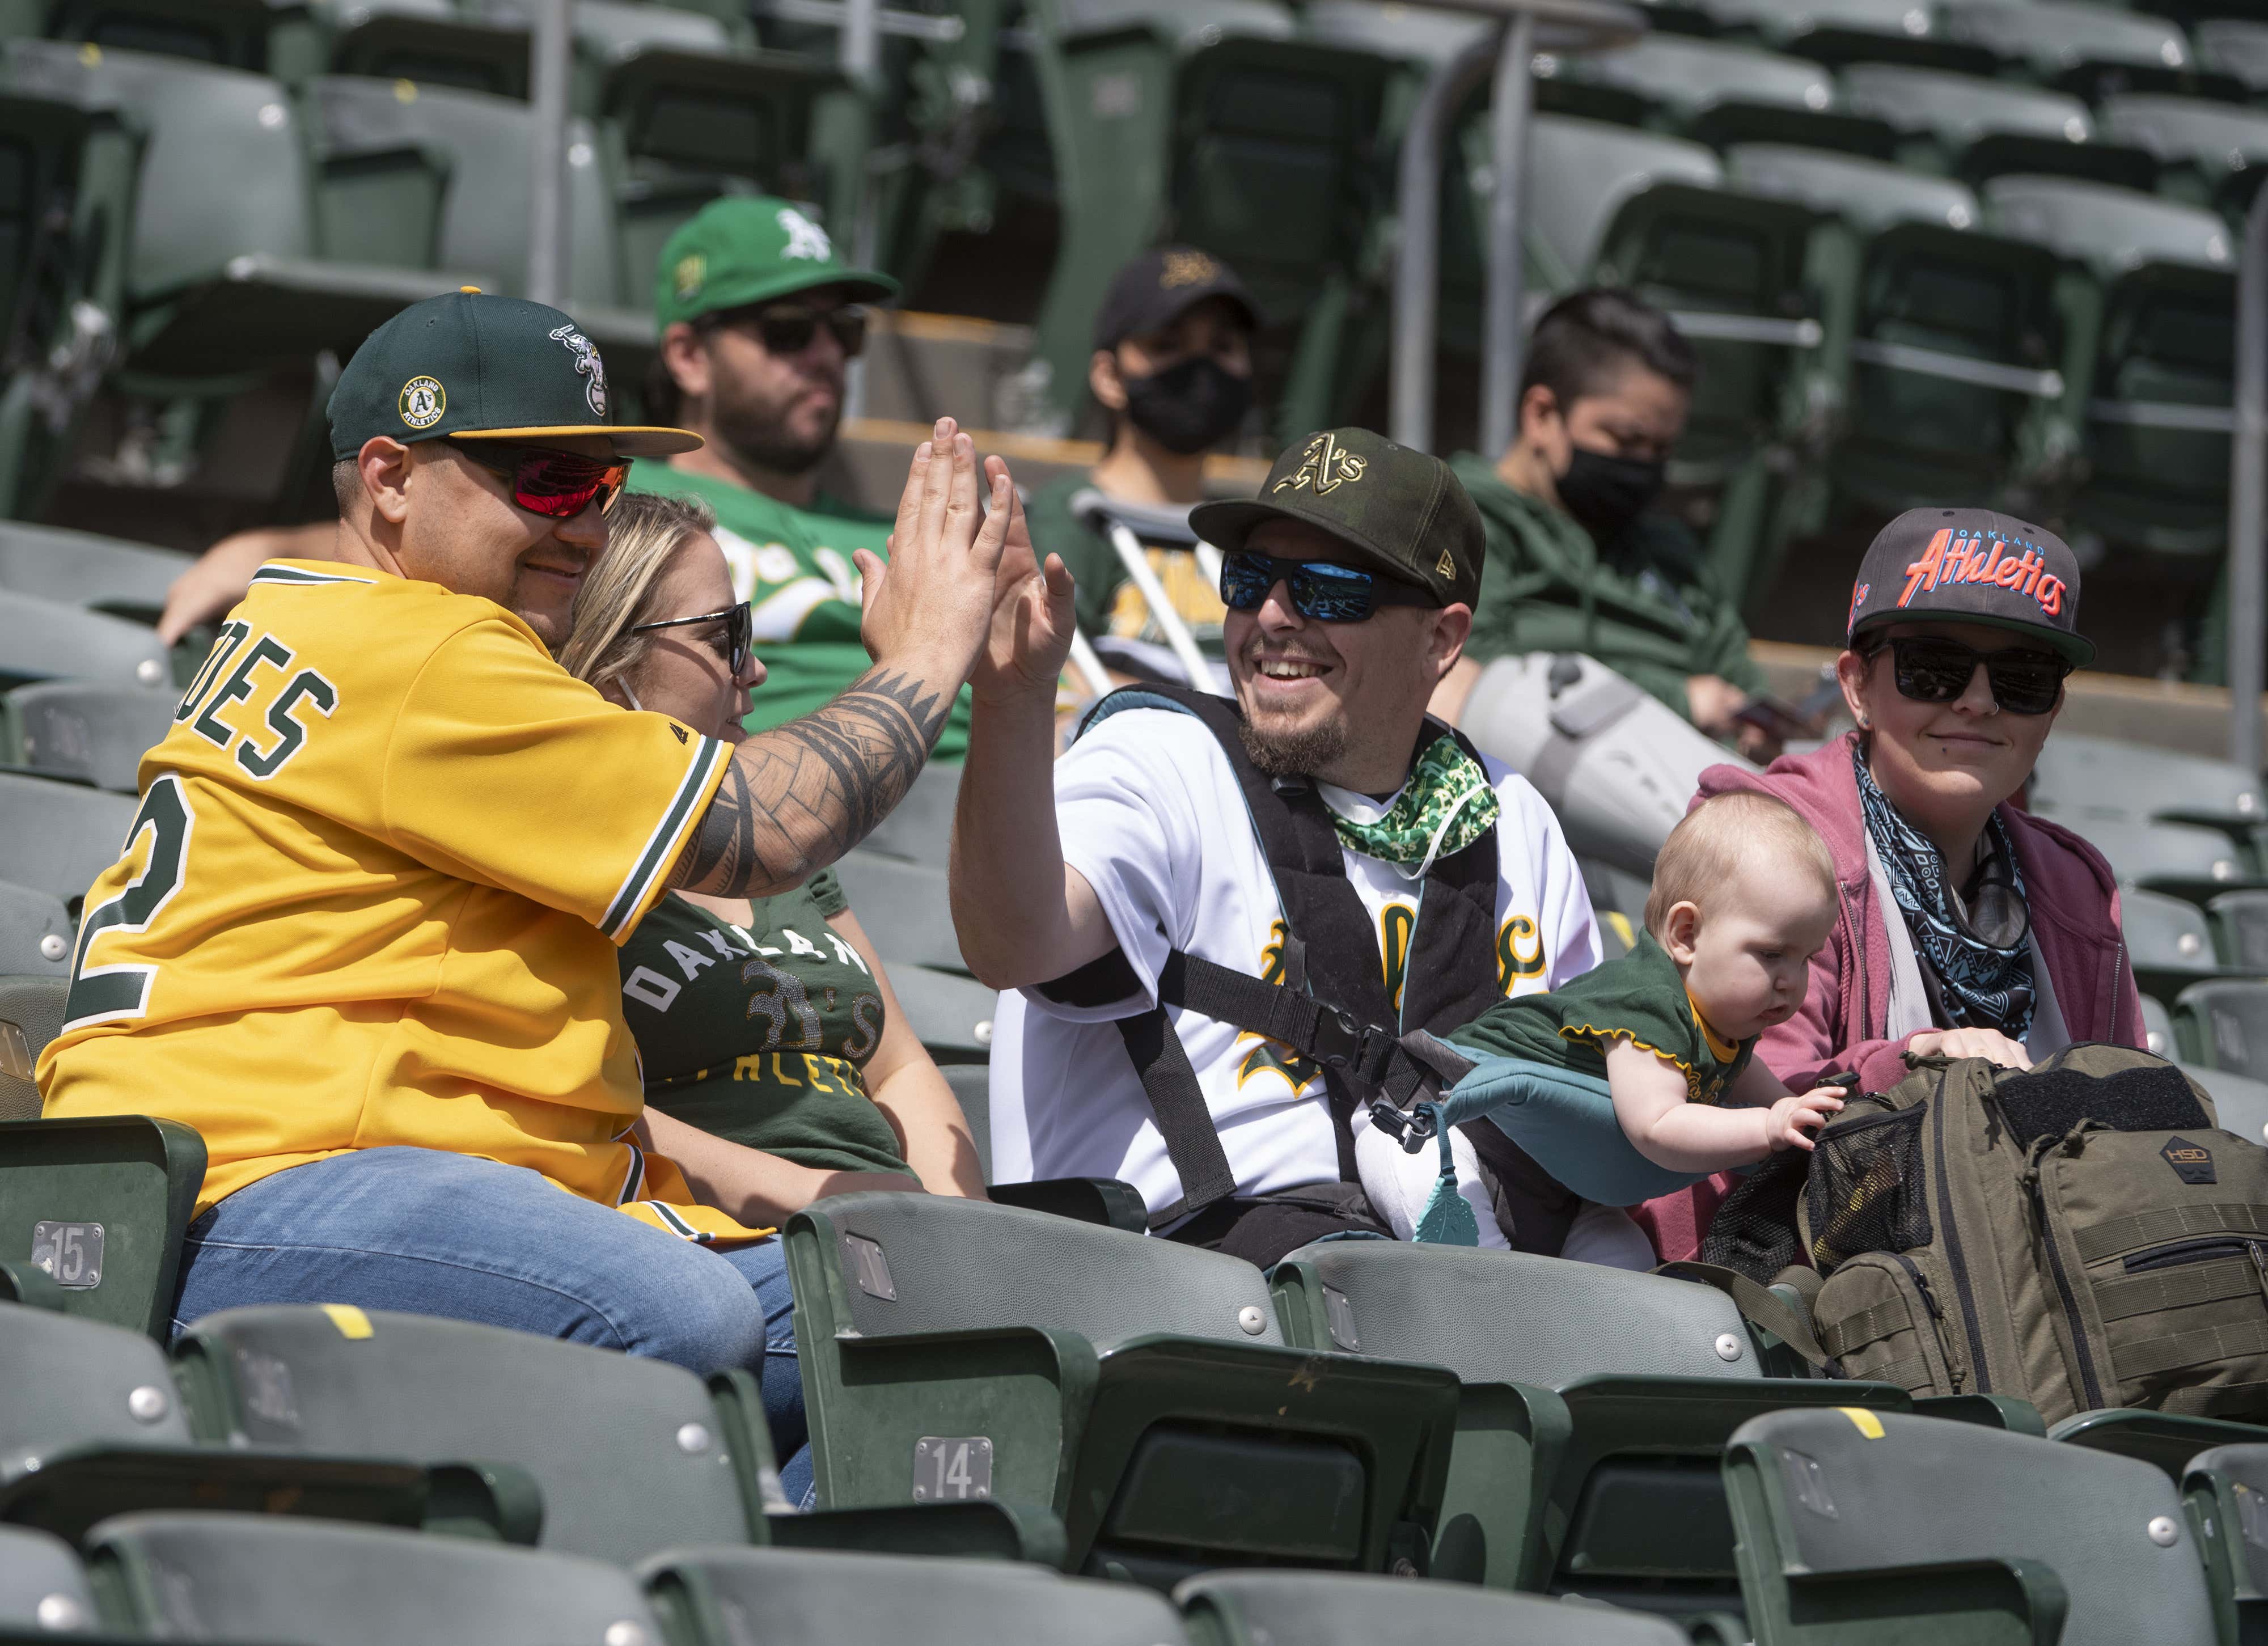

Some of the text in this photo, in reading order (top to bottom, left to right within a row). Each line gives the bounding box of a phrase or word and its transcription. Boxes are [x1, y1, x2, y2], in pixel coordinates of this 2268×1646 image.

[405, 379, 439, 396] OAKLAND
[414, 391, 432, 413] A's
[403, 407, 441, 426] ATHLETICS
[1273, 432, 1368, 496] A's
[1959, 530, 2045, 556] OAKLAND
[1896, 528, 2067, 617] Athletics
[623, 924, 880, 1013] OAKLAN
[2166, 1149, 2208, 1161] HSD
[51, 1227, 84, 1281] 15
[932, 1443, 972, 1499] 14
